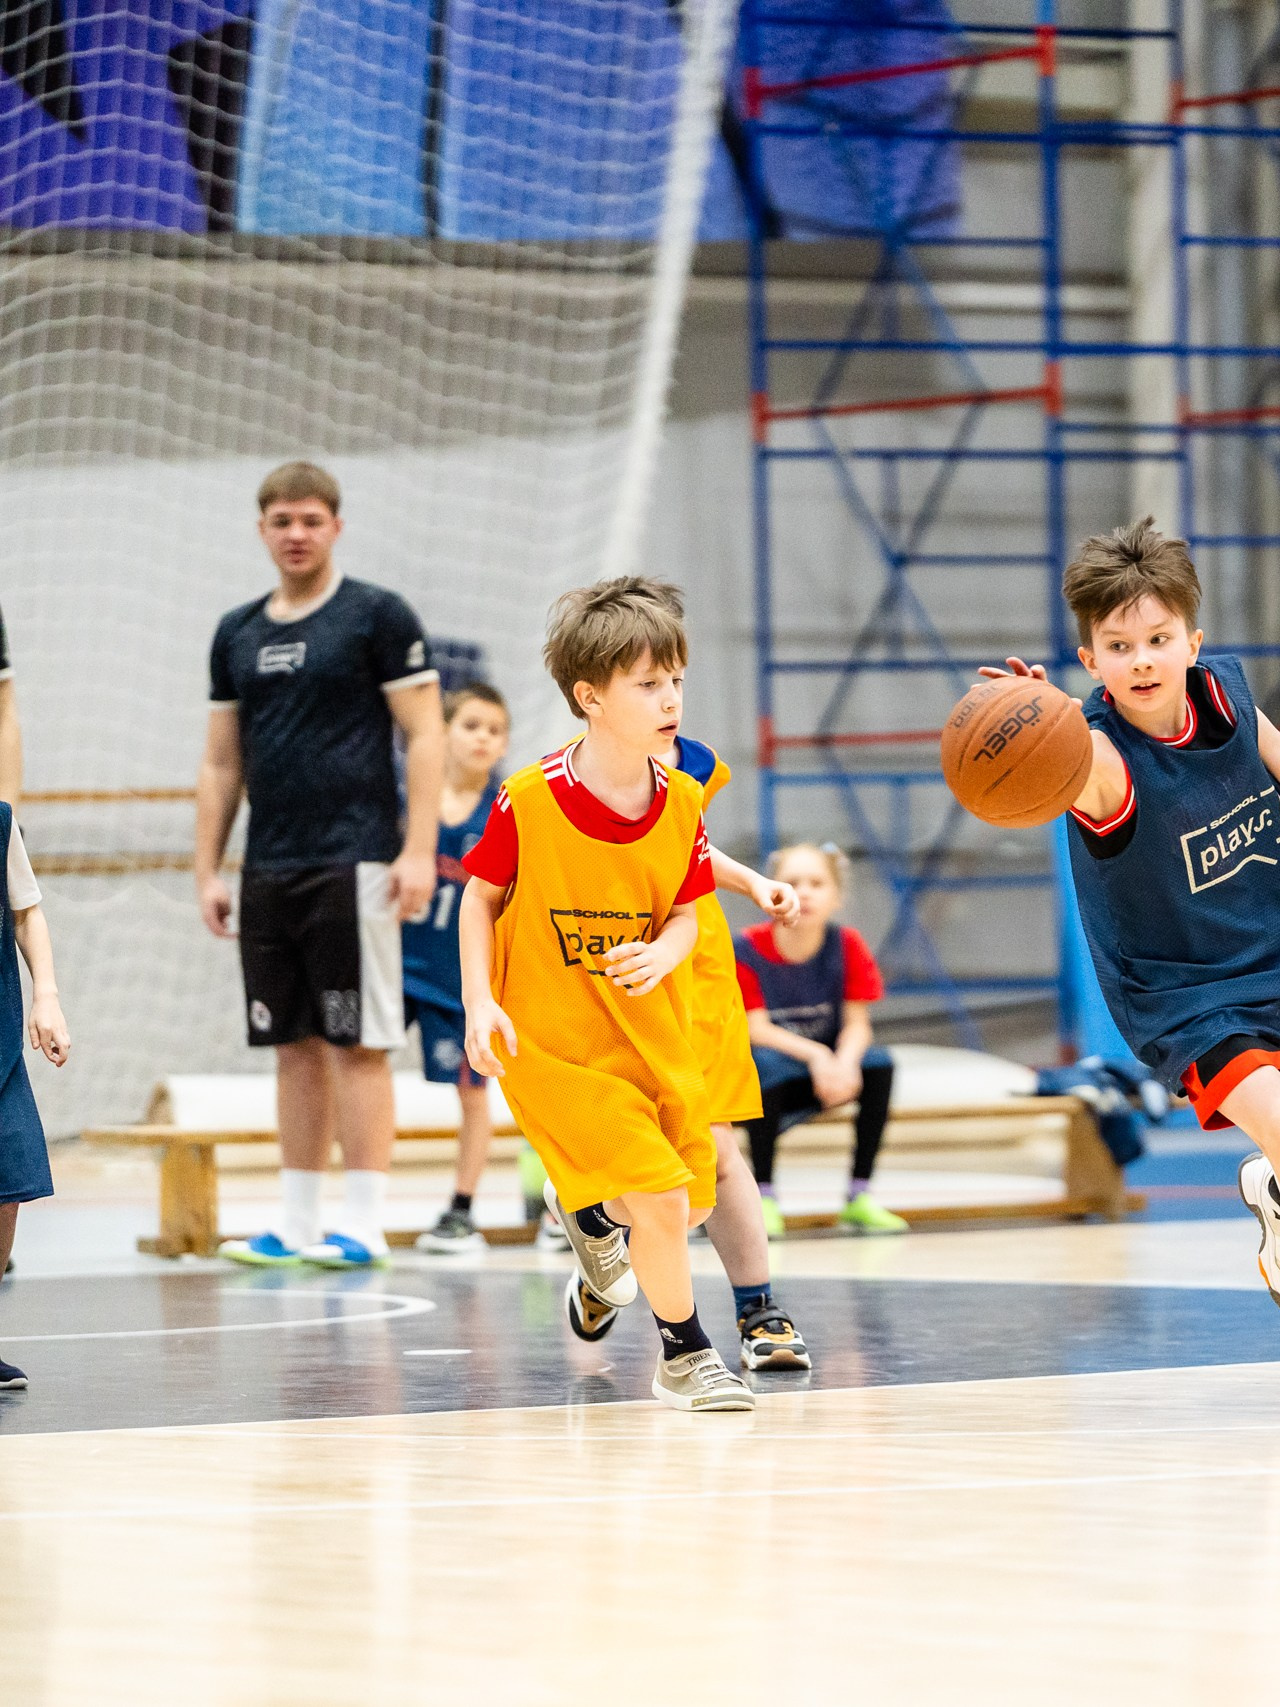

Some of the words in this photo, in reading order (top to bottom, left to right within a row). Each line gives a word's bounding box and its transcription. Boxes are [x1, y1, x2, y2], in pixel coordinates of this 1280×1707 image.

[973, 695, 1043, 761] JÖGEL
[1210, 795, 1258, 829] SCHOOL
[572, 908, 634, 920] SCHOOL
